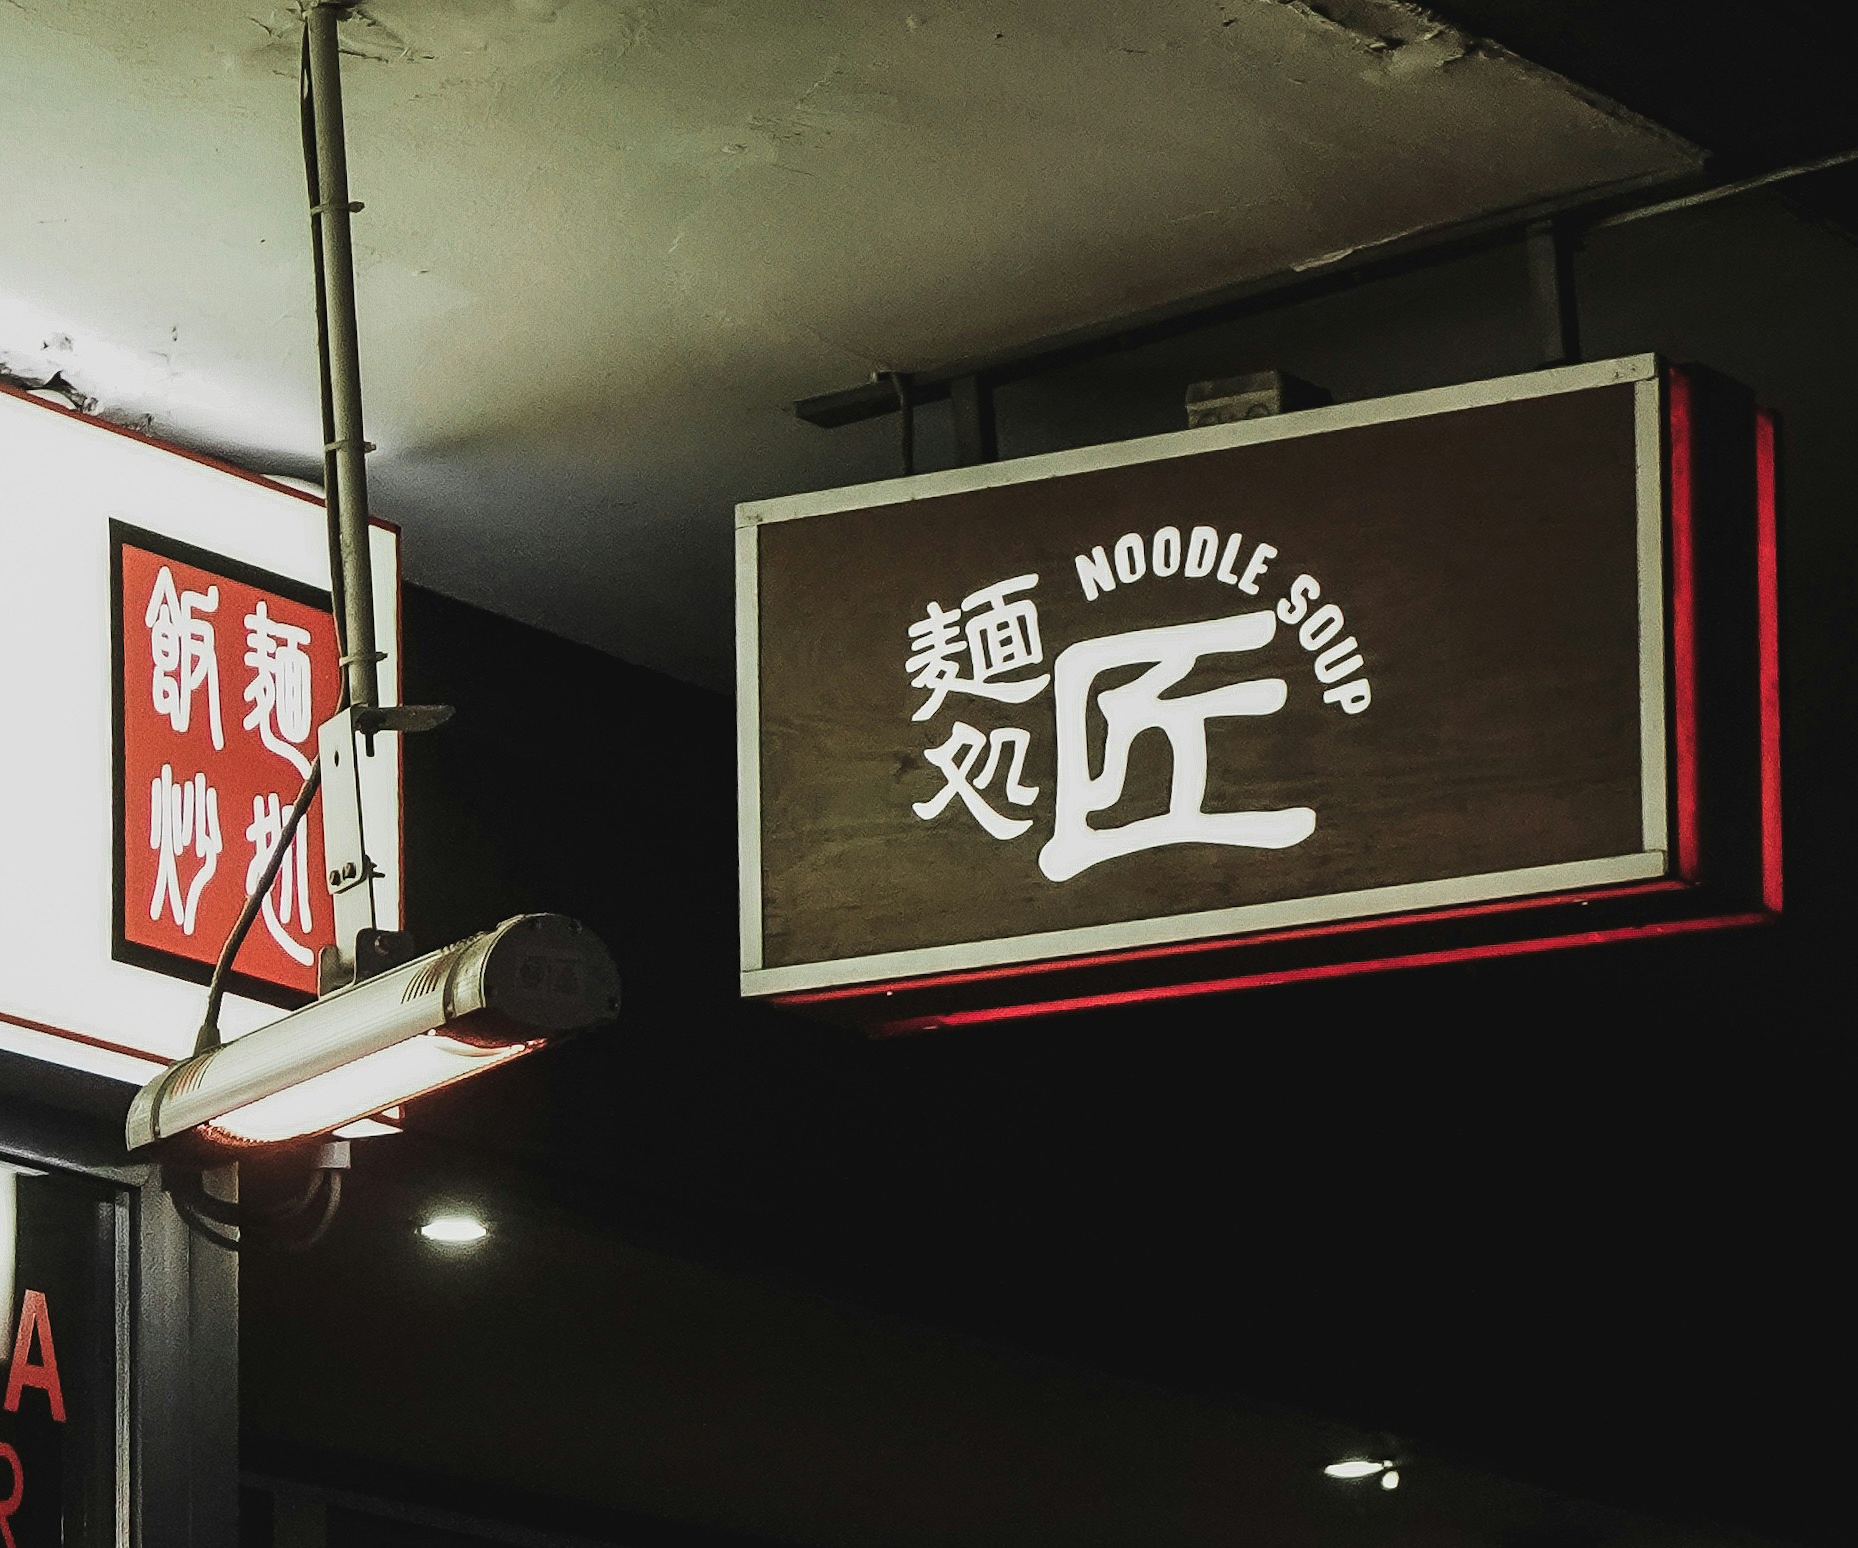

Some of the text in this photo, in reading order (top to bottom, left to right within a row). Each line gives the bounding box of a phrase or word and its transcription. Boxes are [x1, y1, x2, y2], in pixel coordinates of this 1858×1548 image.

[1074, 525, 1372, 715] NOODLE SOUP
[1038, 608, 1317, 883] 匠
